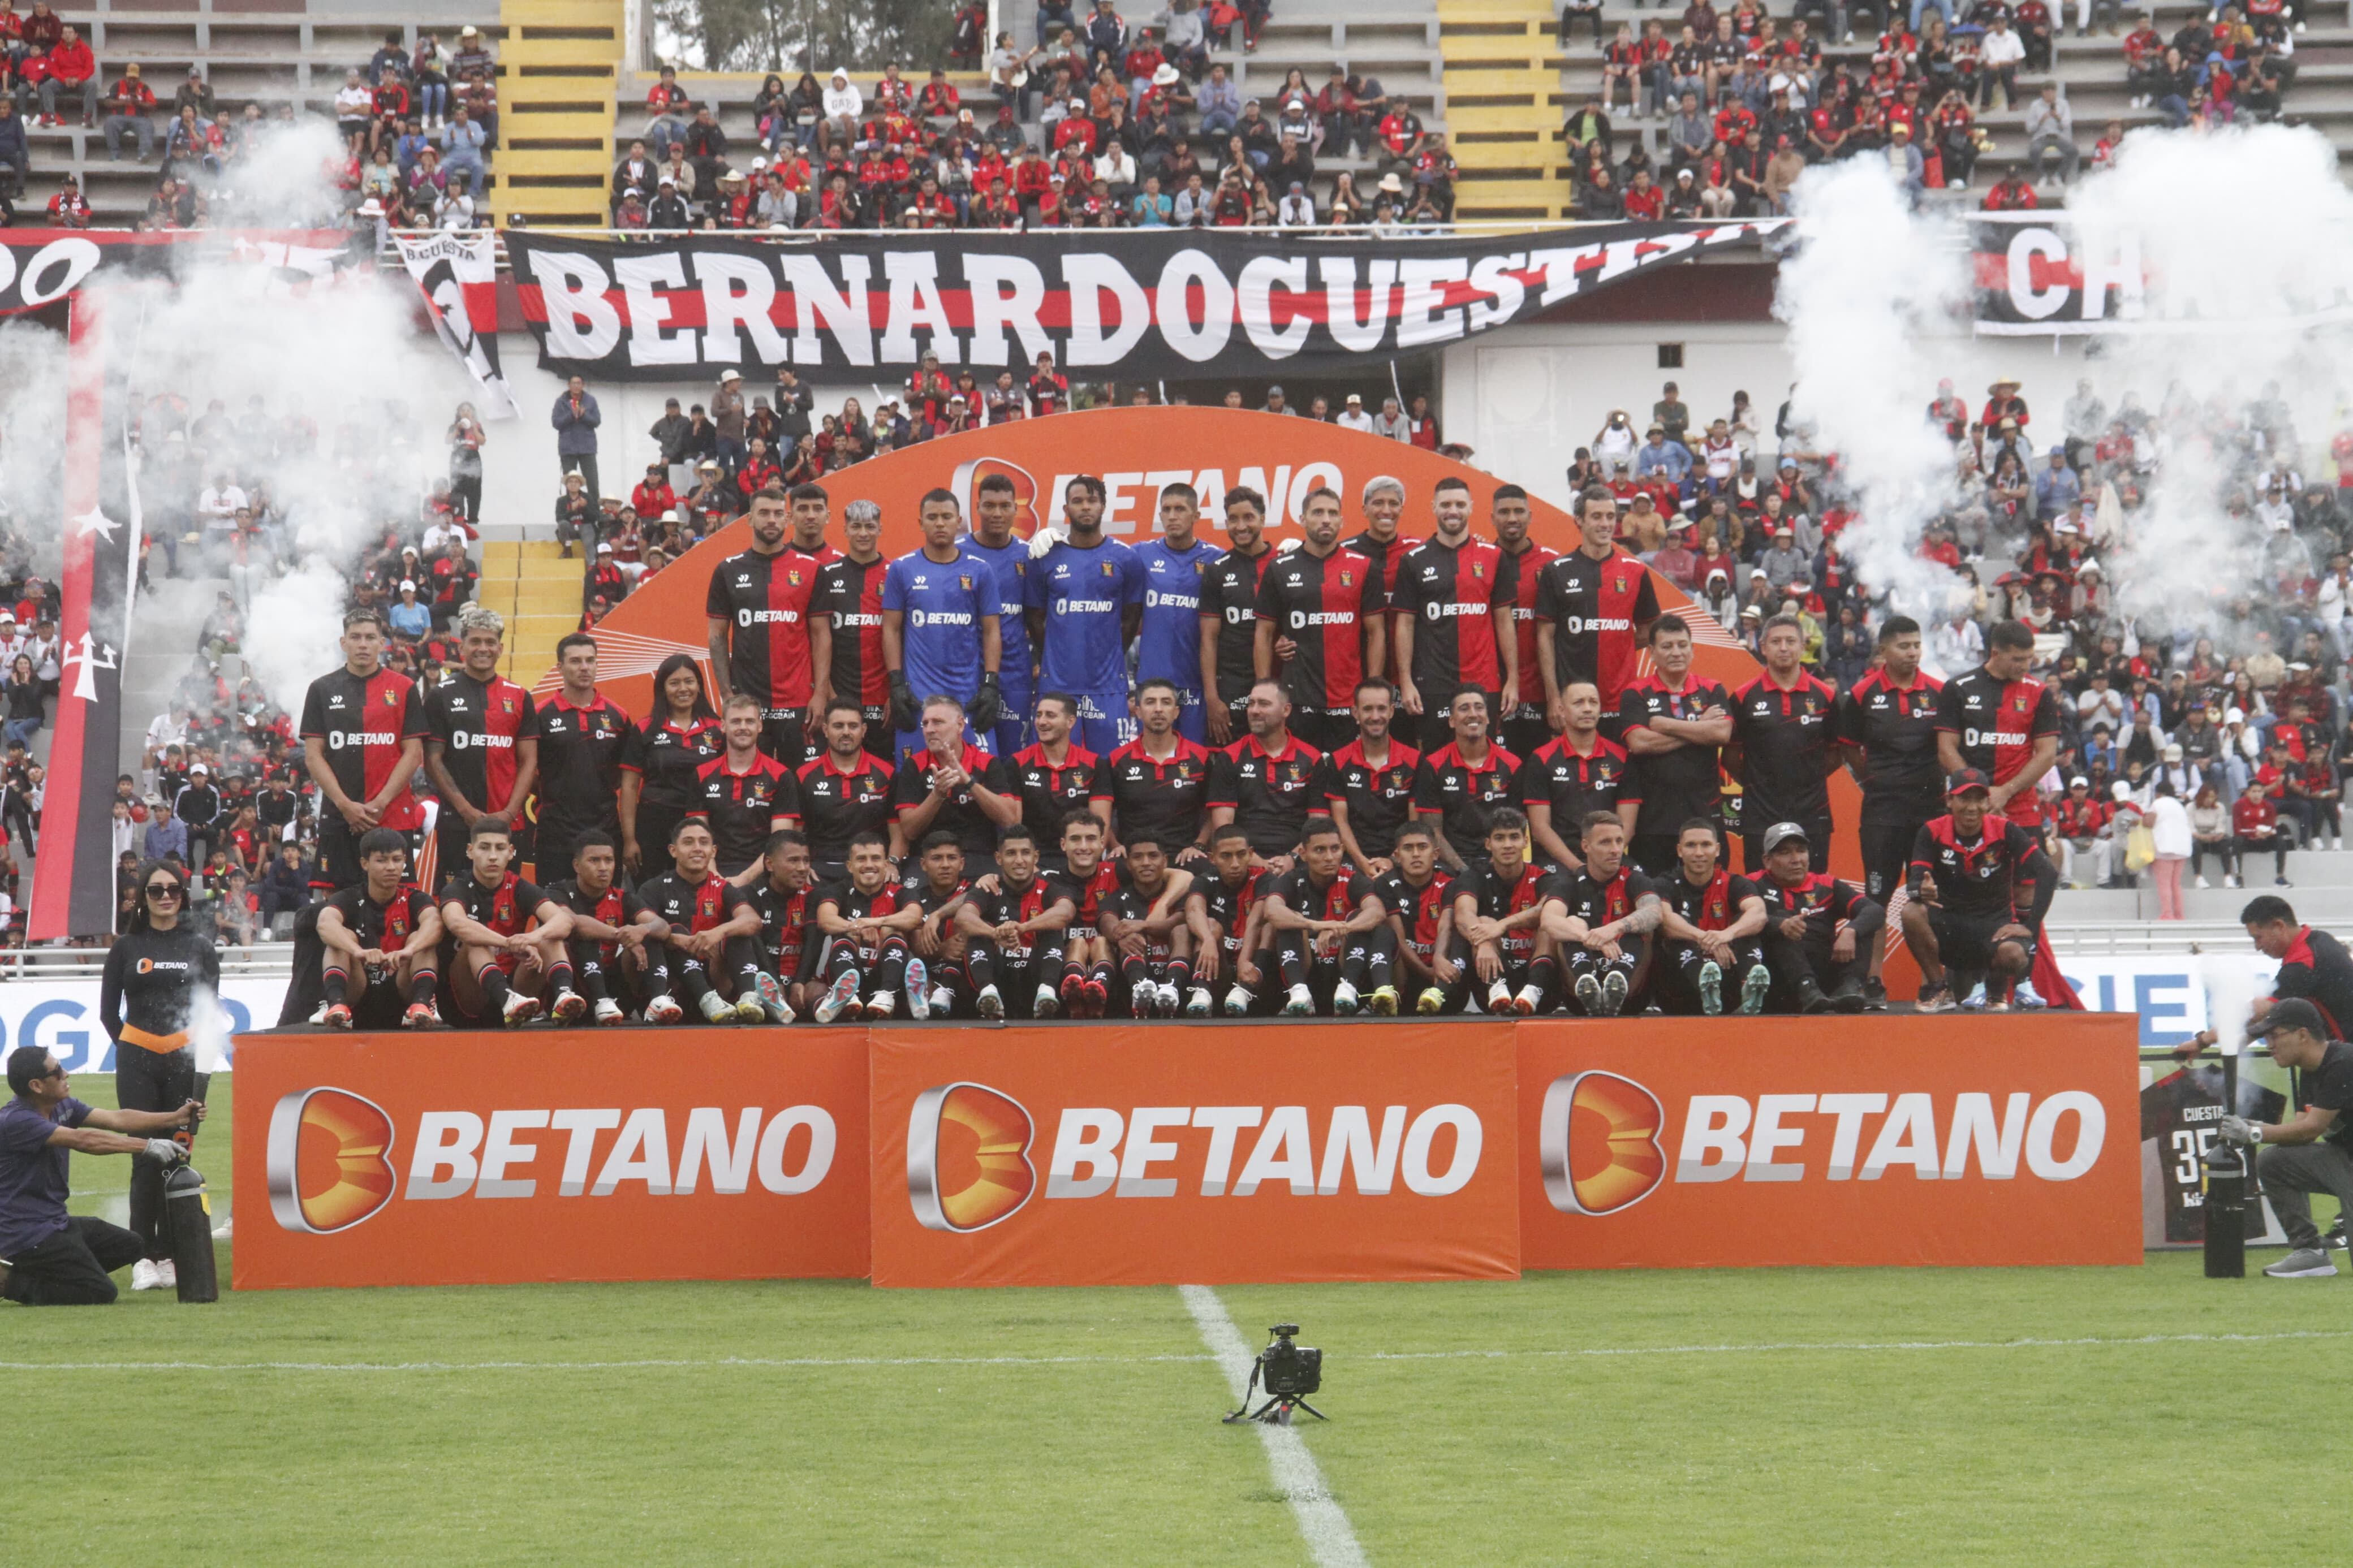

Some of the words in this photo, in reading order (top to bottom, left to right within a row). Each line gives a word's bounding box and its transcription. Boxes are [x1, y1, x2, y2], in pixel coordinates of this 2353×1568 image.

[0, 237, 101, 305] O
[1001, 603, 1022, 615] TANO
[1069, 600, 1113, 612] BETANO
[1442, 603, 1487, 616] BETANO
[754, 611, 798, 623] BETANO
[844, 614, 883, 626] BETAN
[927, 613, 972, 625] BETANO
[1308, 612, 1354, 625] BETANO
[1512, 607, 1535, 620] ETA
[1584, 619, 1630, 631] BETANO
[347, 733, 395, 746] BETANO
[471, 734, 512, 748] BETANO
[1981, 733, 2027, 745] BETANO
[1069, 927, 1098, 939] BETA
[1501, 938, 1534, 951] ETAN
[1675, 1090, 2106, 1183] BETANO
[404, 1105, 837, 1200] BETANO
[1044, 1103, 1483, 1199] BETANO
